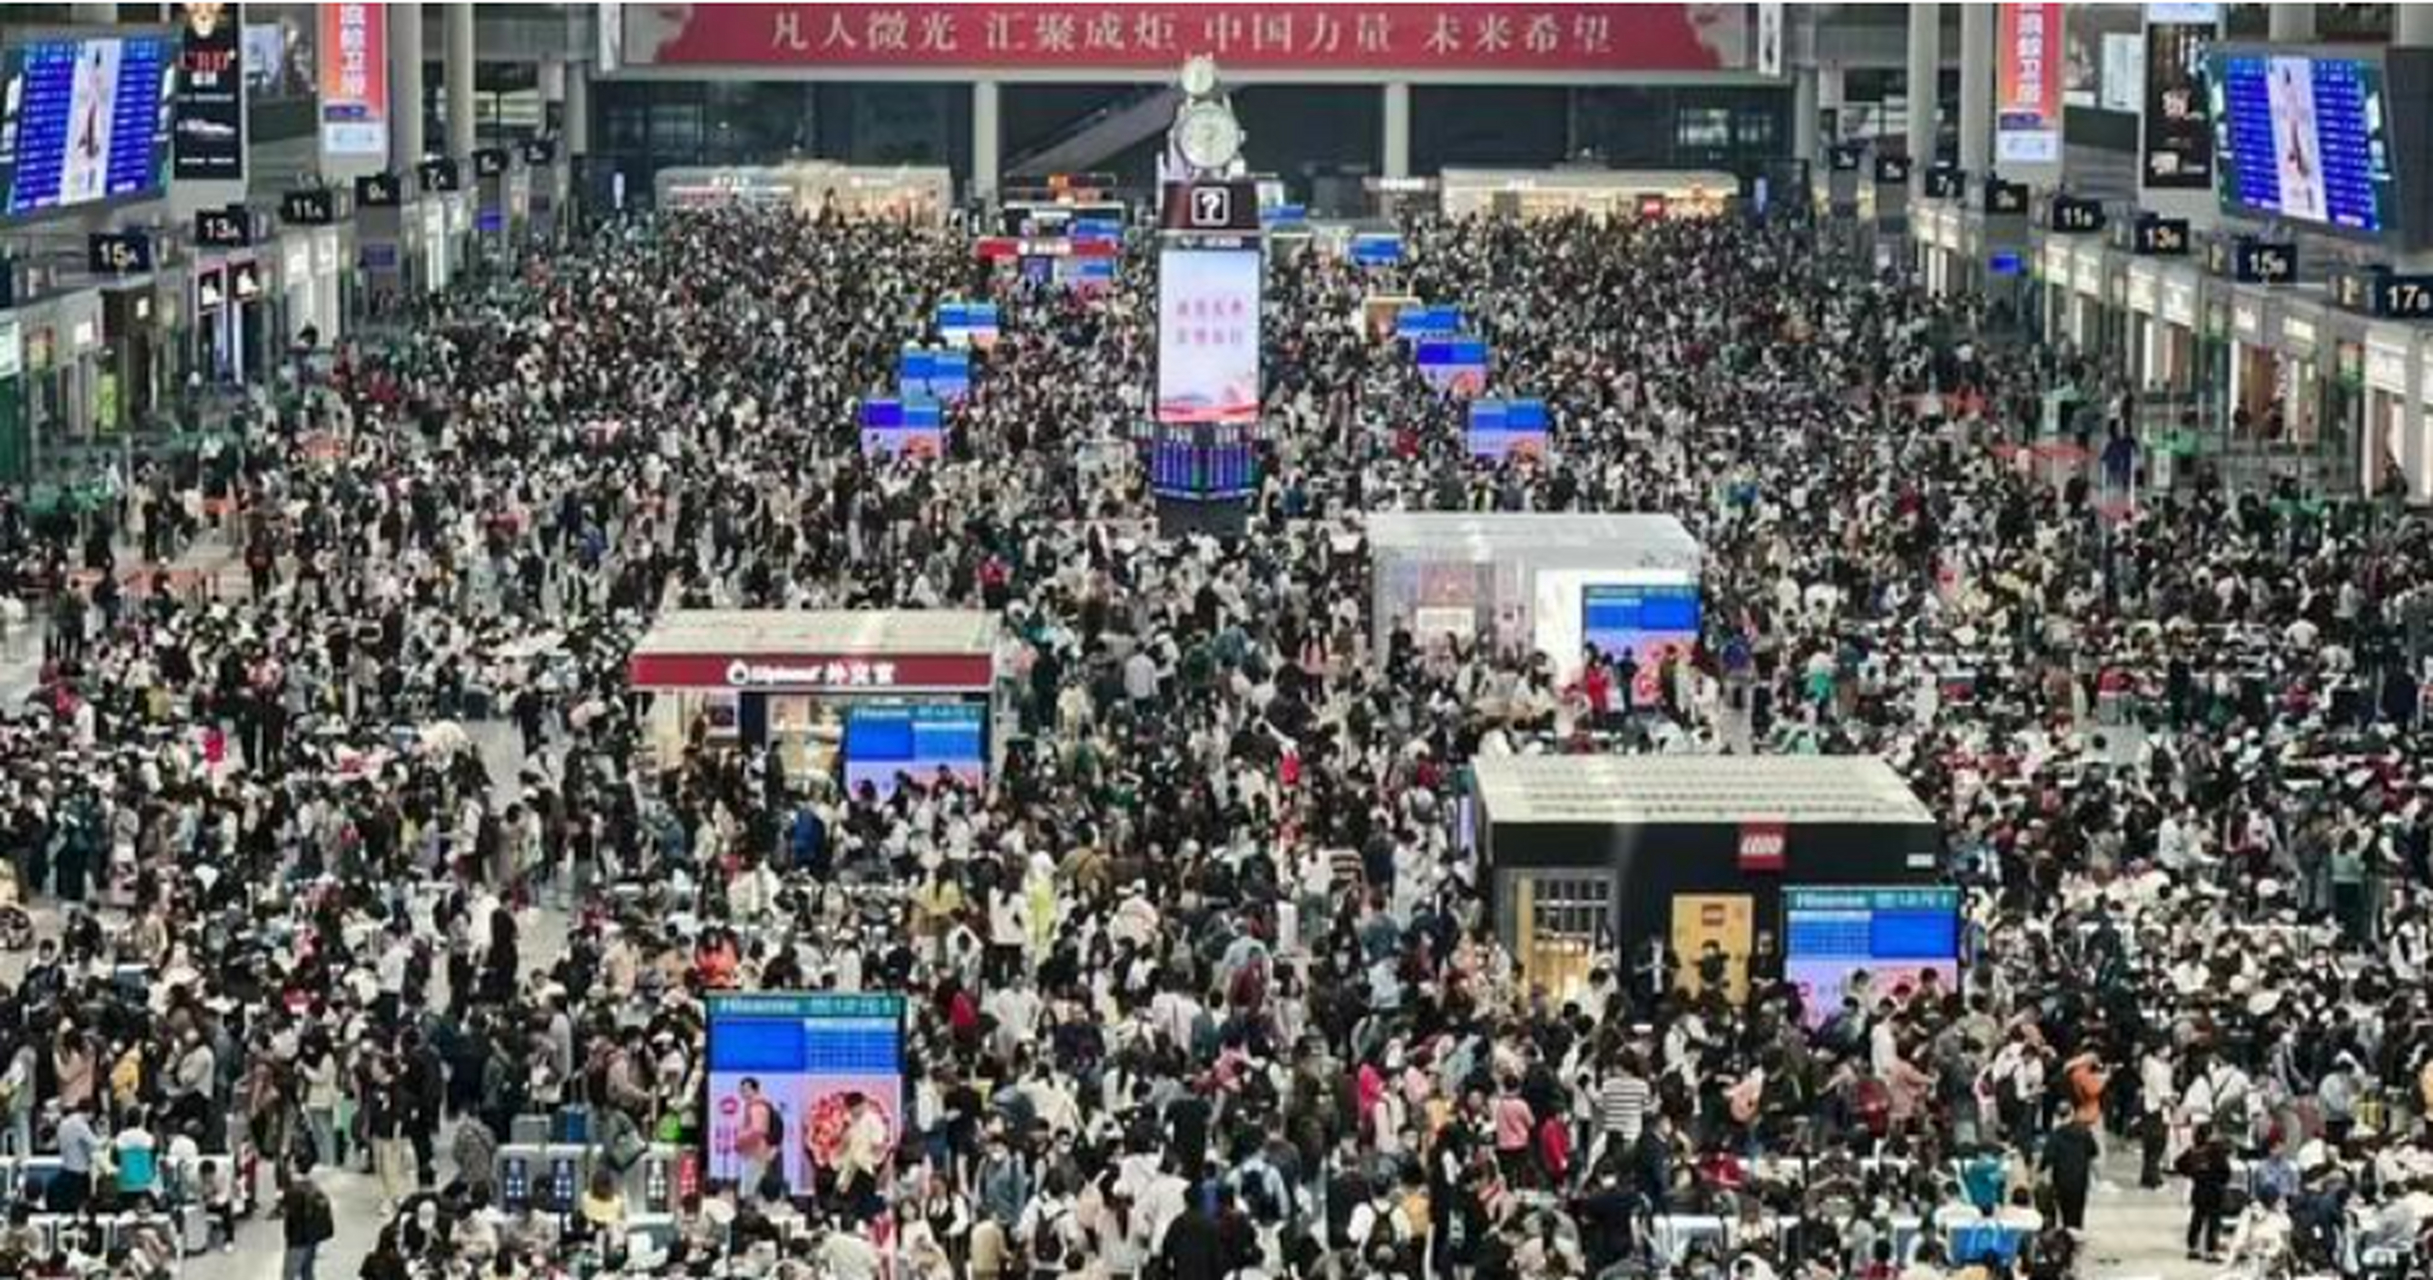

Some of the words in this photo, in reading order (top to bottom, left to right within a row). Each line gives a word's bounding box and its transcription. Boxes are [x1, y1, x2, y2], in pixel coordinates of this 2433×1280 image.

[772, 11, 957, 51] 凡人微光
[986, 11, 1177, 51] 汇聚成炬
[1204, 12, 1390, 53] 中国力量
[1424, 12, 1612, 53] 未来希望
[292, 200, 323, 218] 11A
[204, 217, 241, 239] 13A
[100, 240, 139, 268] 15A
[1740, 835, 1784, 856] LEGO
